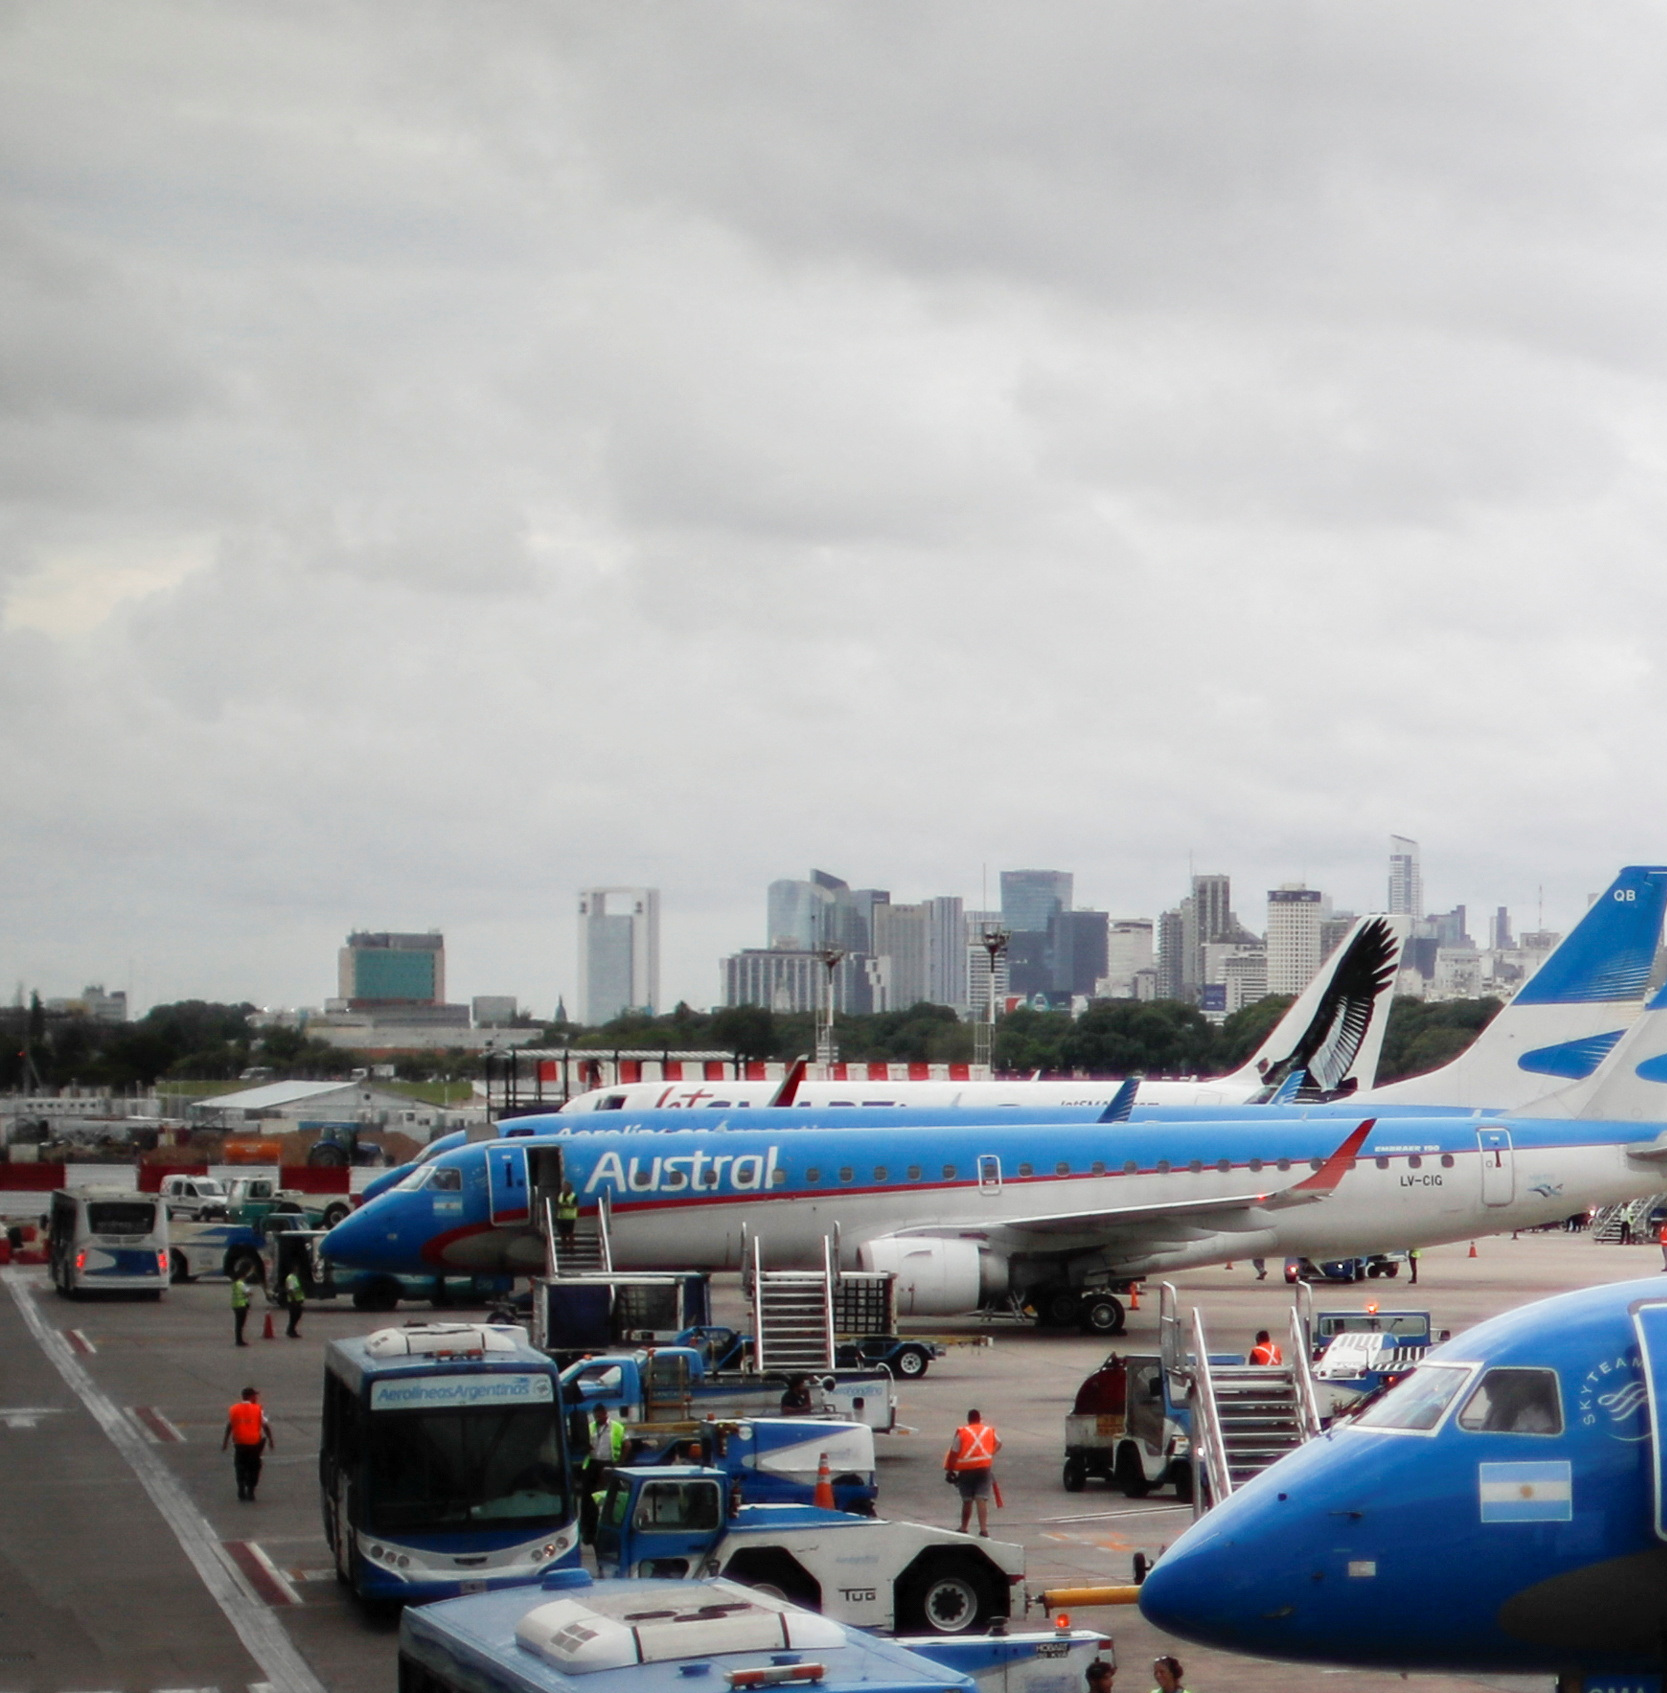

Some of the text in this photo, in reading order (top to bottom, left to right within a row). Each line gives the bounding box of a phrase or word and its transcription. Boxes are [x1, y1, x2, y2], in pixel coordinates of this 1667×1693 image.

[1613, 889, 1636, 902] QB
[584, 1145, 779, 1194] Austral
[1400, 1174, 1443, 1187] LV-CIG
